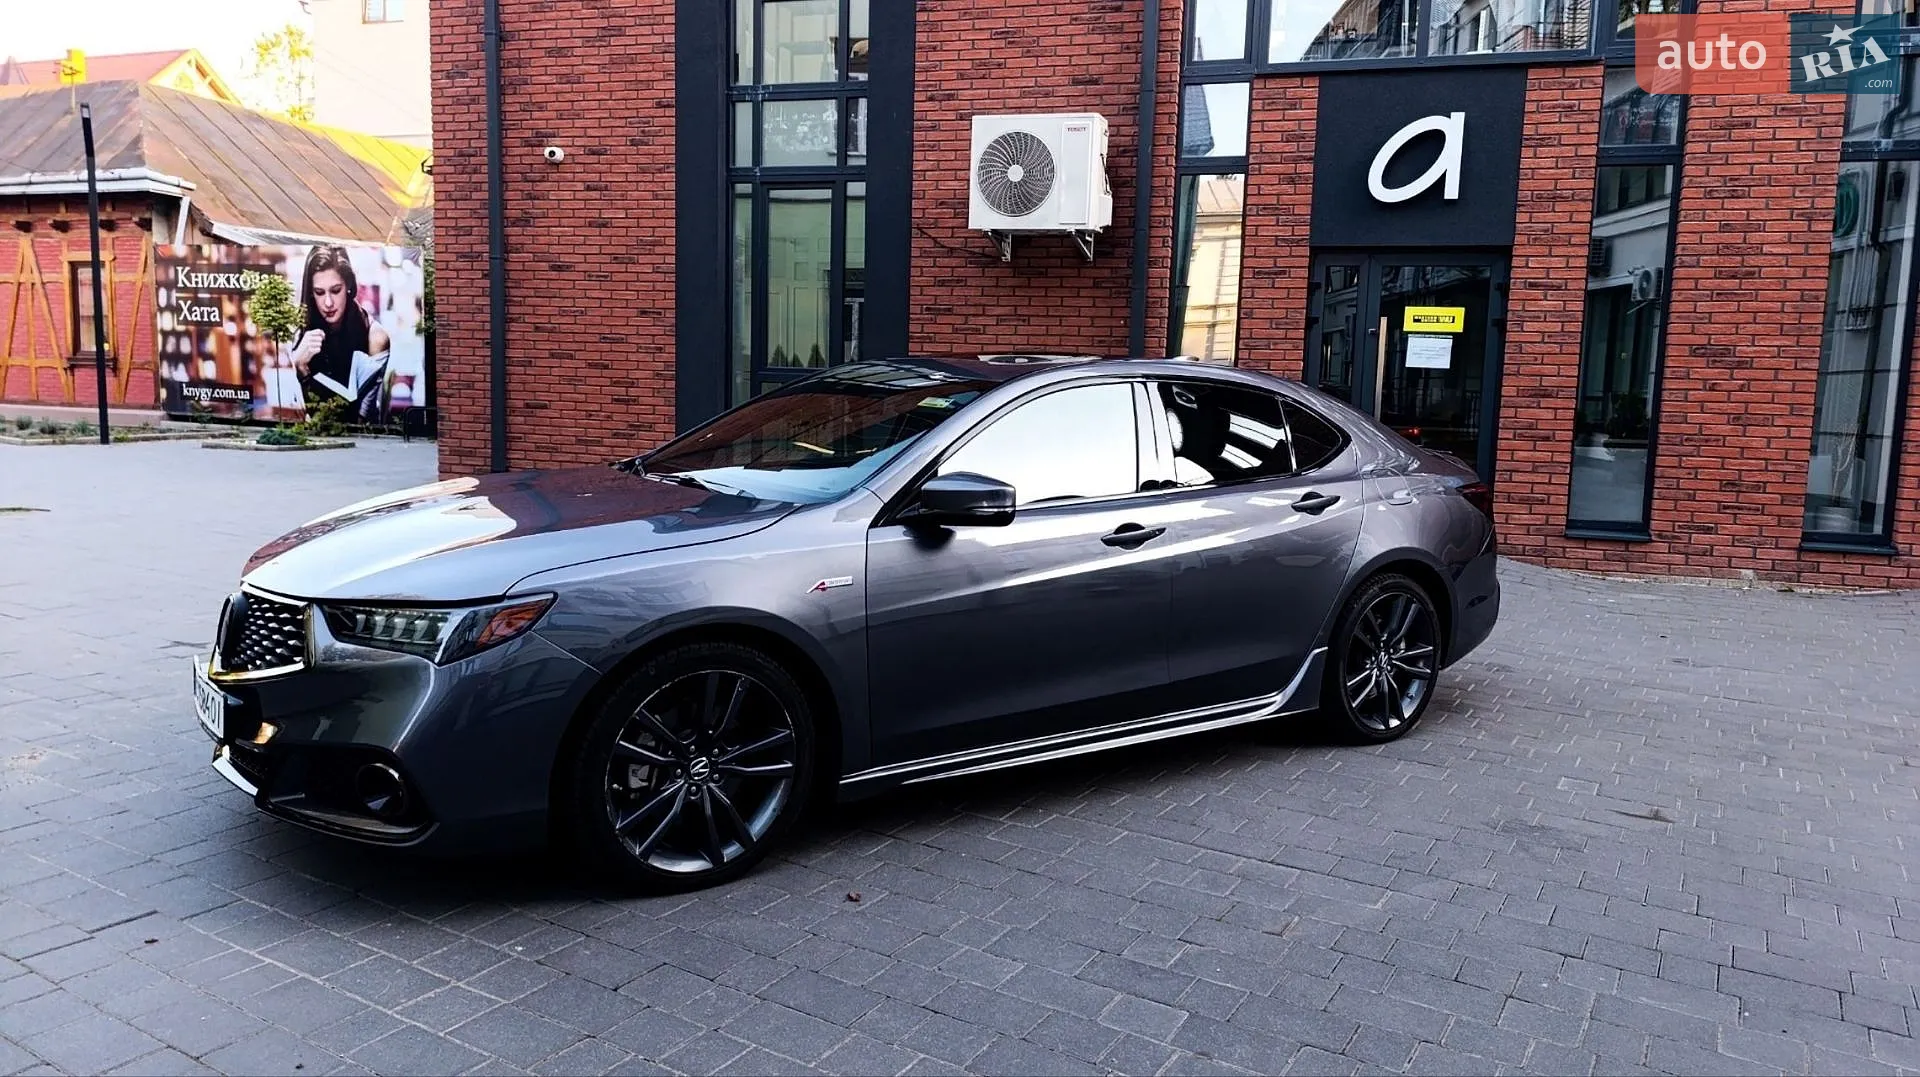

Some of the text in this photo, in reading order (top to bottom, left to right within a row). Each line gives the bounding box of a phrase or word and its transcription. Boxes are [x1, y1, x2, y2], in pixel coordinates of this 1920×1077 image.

[1367, 111, 1466, 203] a
[178, 300, 220, 322] Хата
[182, 383, 250, 400] knygy.com.ua
